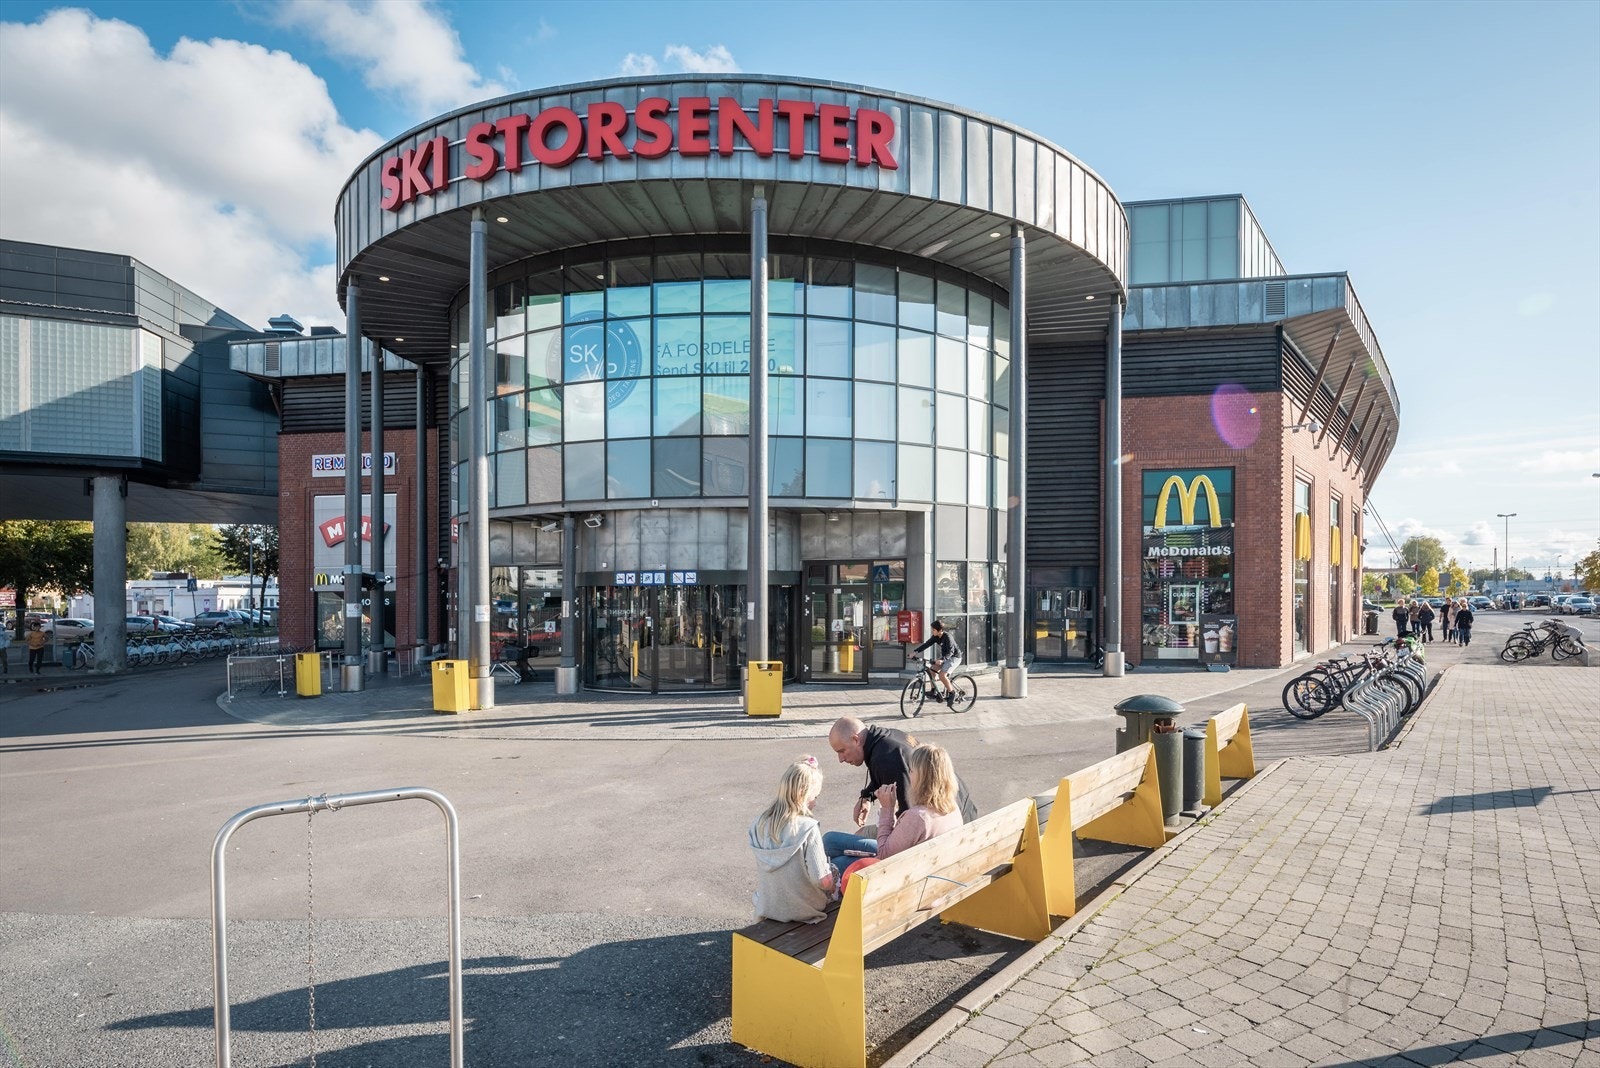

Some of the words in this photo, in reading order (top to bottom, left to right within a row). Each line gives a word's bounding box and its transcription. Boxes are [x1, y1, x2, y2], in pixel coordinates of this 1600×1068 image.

[380, 136, 449, 212] SKI
[464, 96, 899, 183] STORSENTER
[677, 338, 776, 358] FORDELEE
[656, 362, 689, 376] Send
[693, 361, 720, 374] SKI
[724, 360, 735, 373] til
[740, 358, 776, 374] 20
[313, 455, 346, 470] REM
[1148, 546, 1231, 557] McDonald's
